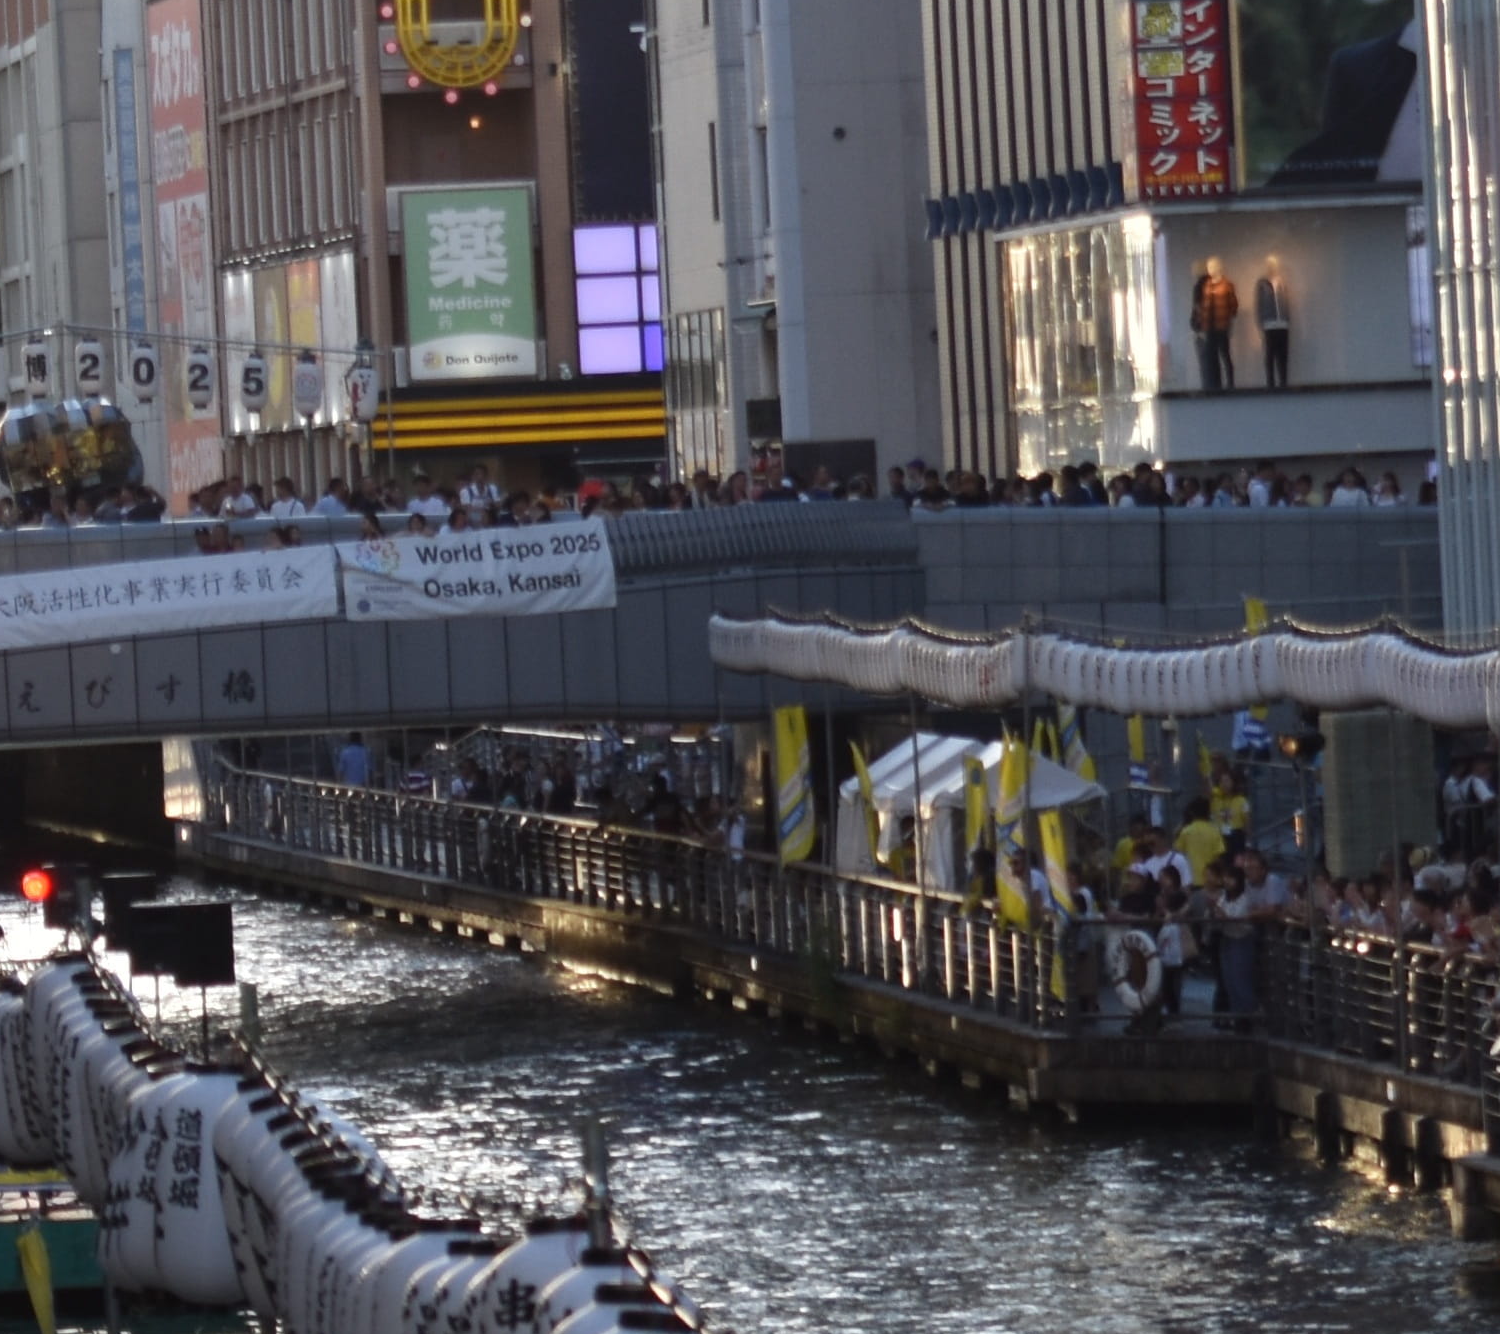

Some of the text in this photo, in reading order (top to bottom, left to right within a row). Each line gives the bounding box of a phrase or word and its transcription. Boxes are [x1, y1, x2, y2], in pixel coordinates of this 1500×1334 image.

[1183, 0, 1223, 174] インターネット
[1146, 78, 1181, 176] コミック
[426, 207, 508, 288] 薬
[428, 296, 513, 312] Medicine
[445, 351, 519, 366] Don Quijote
[415, 533, 601, 565] World Expo 2025
[423, 564, 581, 599] Osaka, Kansai
